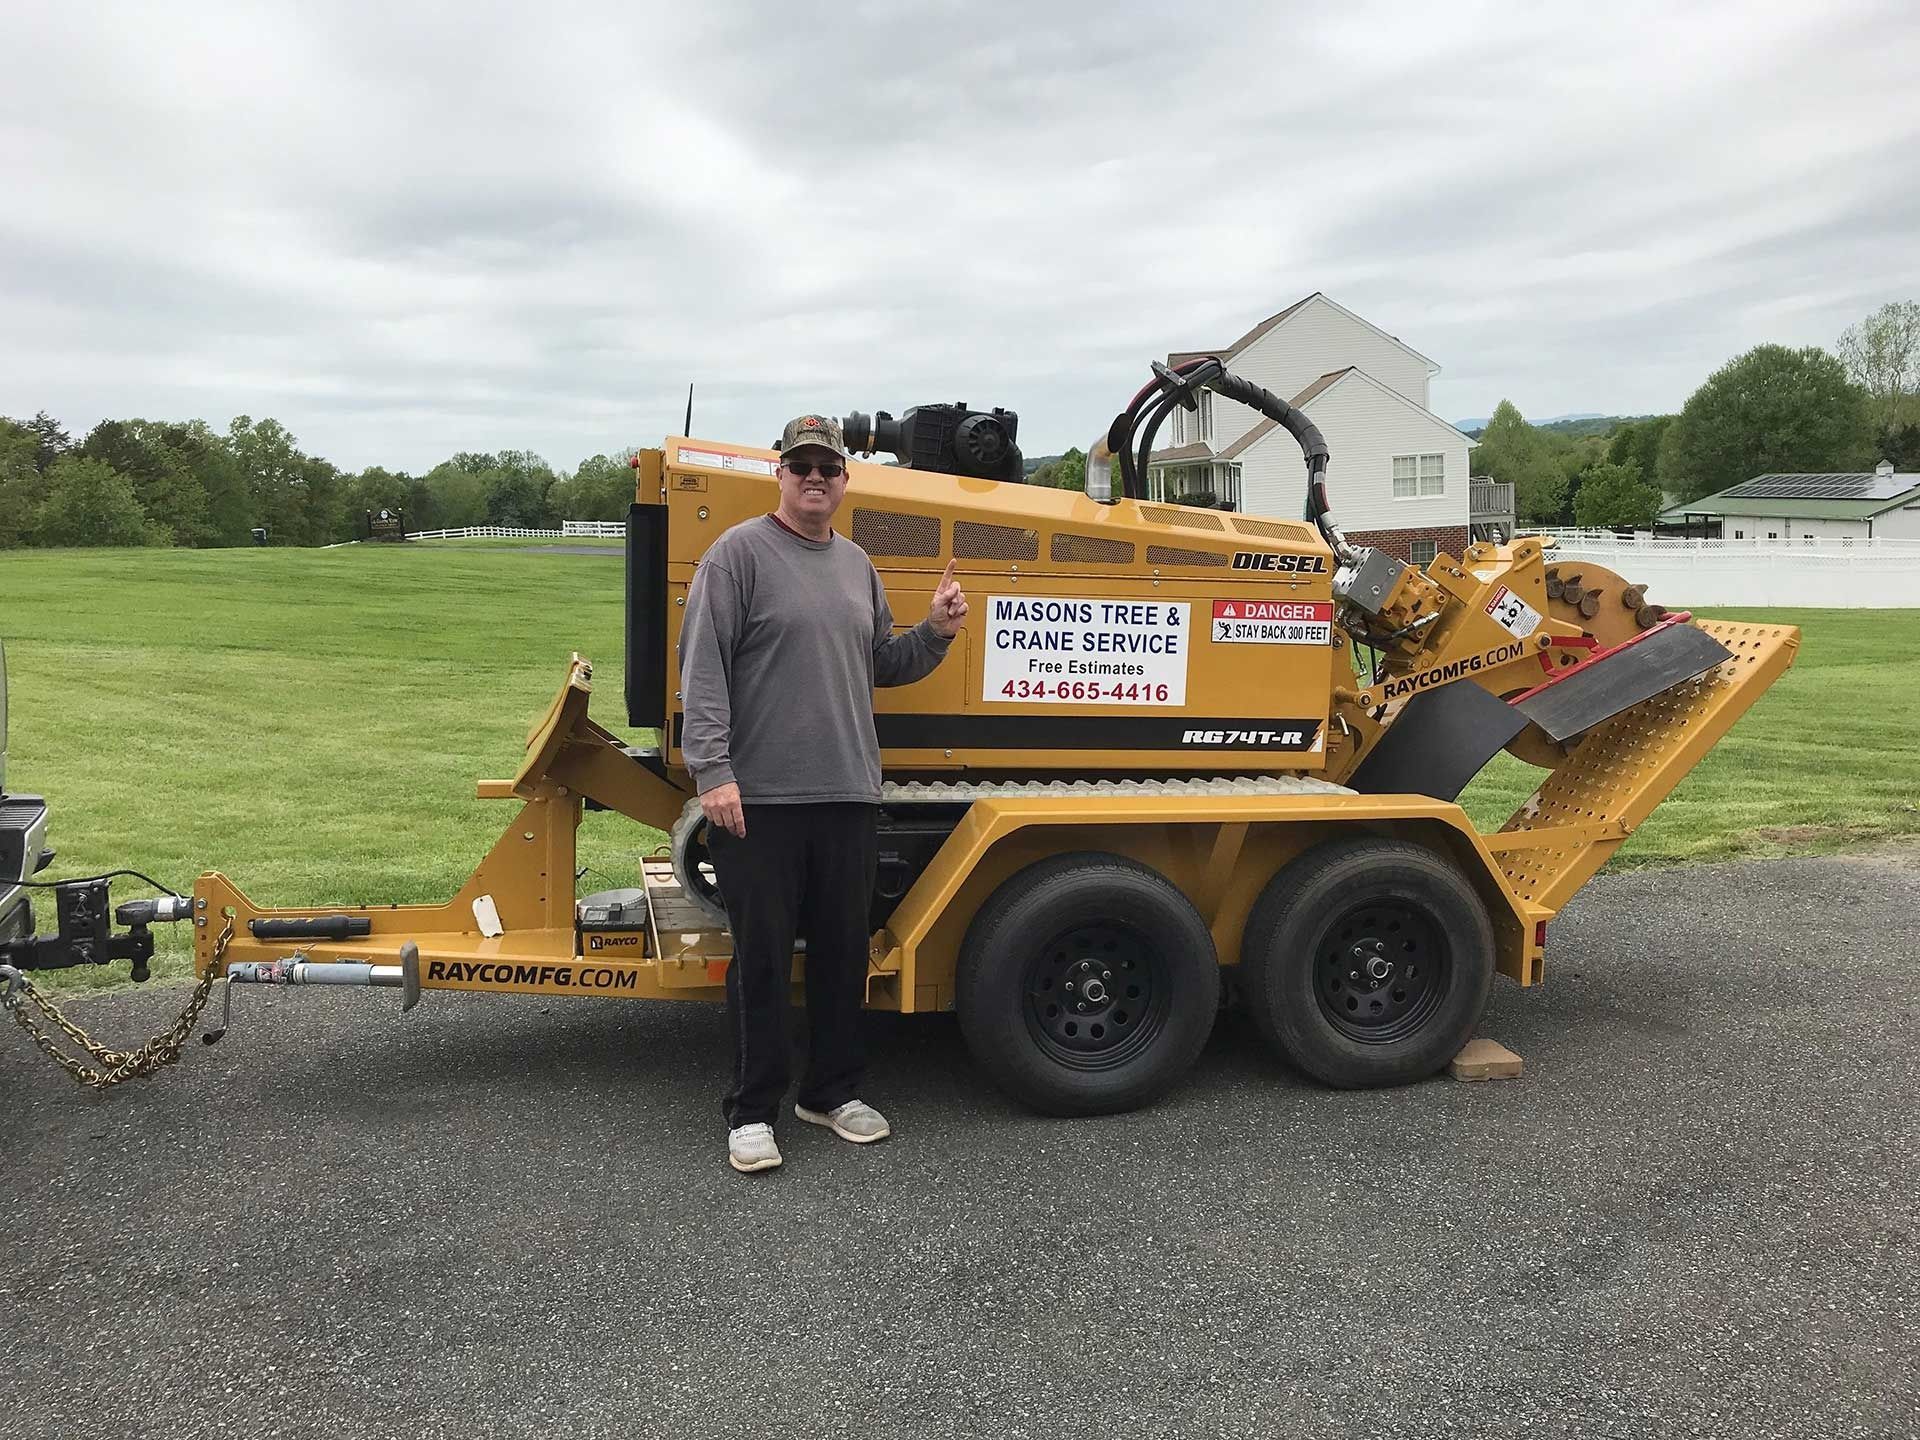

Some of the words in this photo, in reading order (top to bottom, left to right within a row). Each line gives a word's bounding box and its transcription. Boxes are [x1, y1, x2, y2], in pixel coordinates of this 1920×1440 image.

[1231, 552, 1328, 574] DIESEL
[996, 600, 1092, 623] MASONS
[1101, 604, 1158, 625] TREE
[1166, 606, 1180, 626] &
[1245, 603, 1315, 619] DANGER
[996, 629, 1074, 651] CRANE
[1082, 632, 1178, 654] SERVICE
[1235, 624, 1260, 639] STAY
[1261, 625, 1287, 639] BACK
[1288, 626, 1304, 640] 300
[1305, 626, 1328, 641] FEET
[1029, 659, 1062, 673] Free
[1068, 660, 1144, 675] Estimates
[1384, 641, 1524, 700] RAYCOMFG.COM
[1001, 680, 1169, 701] 434-665-4416
[1182, 730, 1303, 745] RG74T-R
[604, 936, 638, 946] RAYCO
[428, 961, 637, 989] RAYCOMFG.COM
